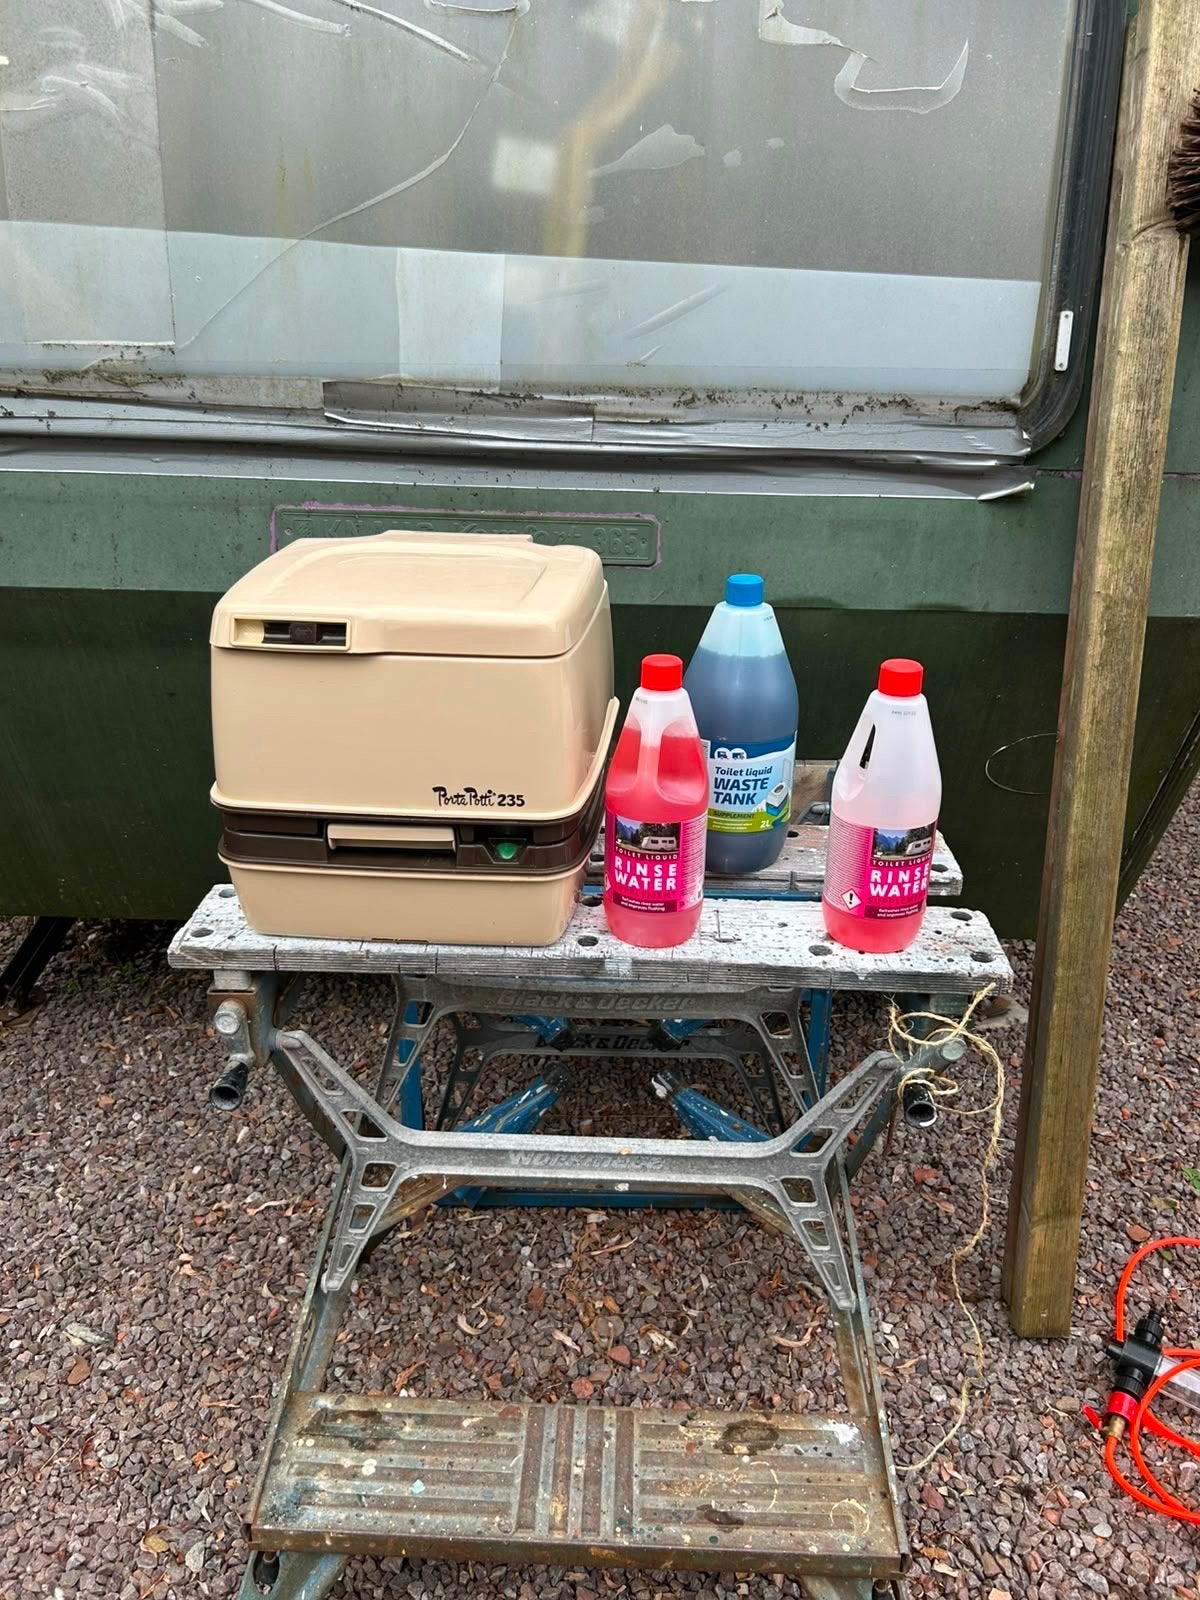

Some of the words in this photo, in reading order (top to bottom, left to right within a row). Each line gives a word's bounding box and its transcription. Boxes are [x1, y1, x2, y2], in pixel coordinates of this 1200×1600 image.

[592, 527, 639, 555] 365
[714, 766, 745, 777] Toilet
[745, 765, 773, 778] liquid
[714, 776, 770, 792] WASTE
[497, 794, 525, 807] 235
[713, 791, 758, 806] TANK
[615, 846, 641, 859] TOILET
[614, 855, 678, 877] RINSE
[870, 862, 930, 884] RINSE
[614, 868, 677, 892] WATER
[869, 877, 928, 898] WATER
[496, 990, 571, 1009] Black
[596, 993, 695, 1011] Decker
